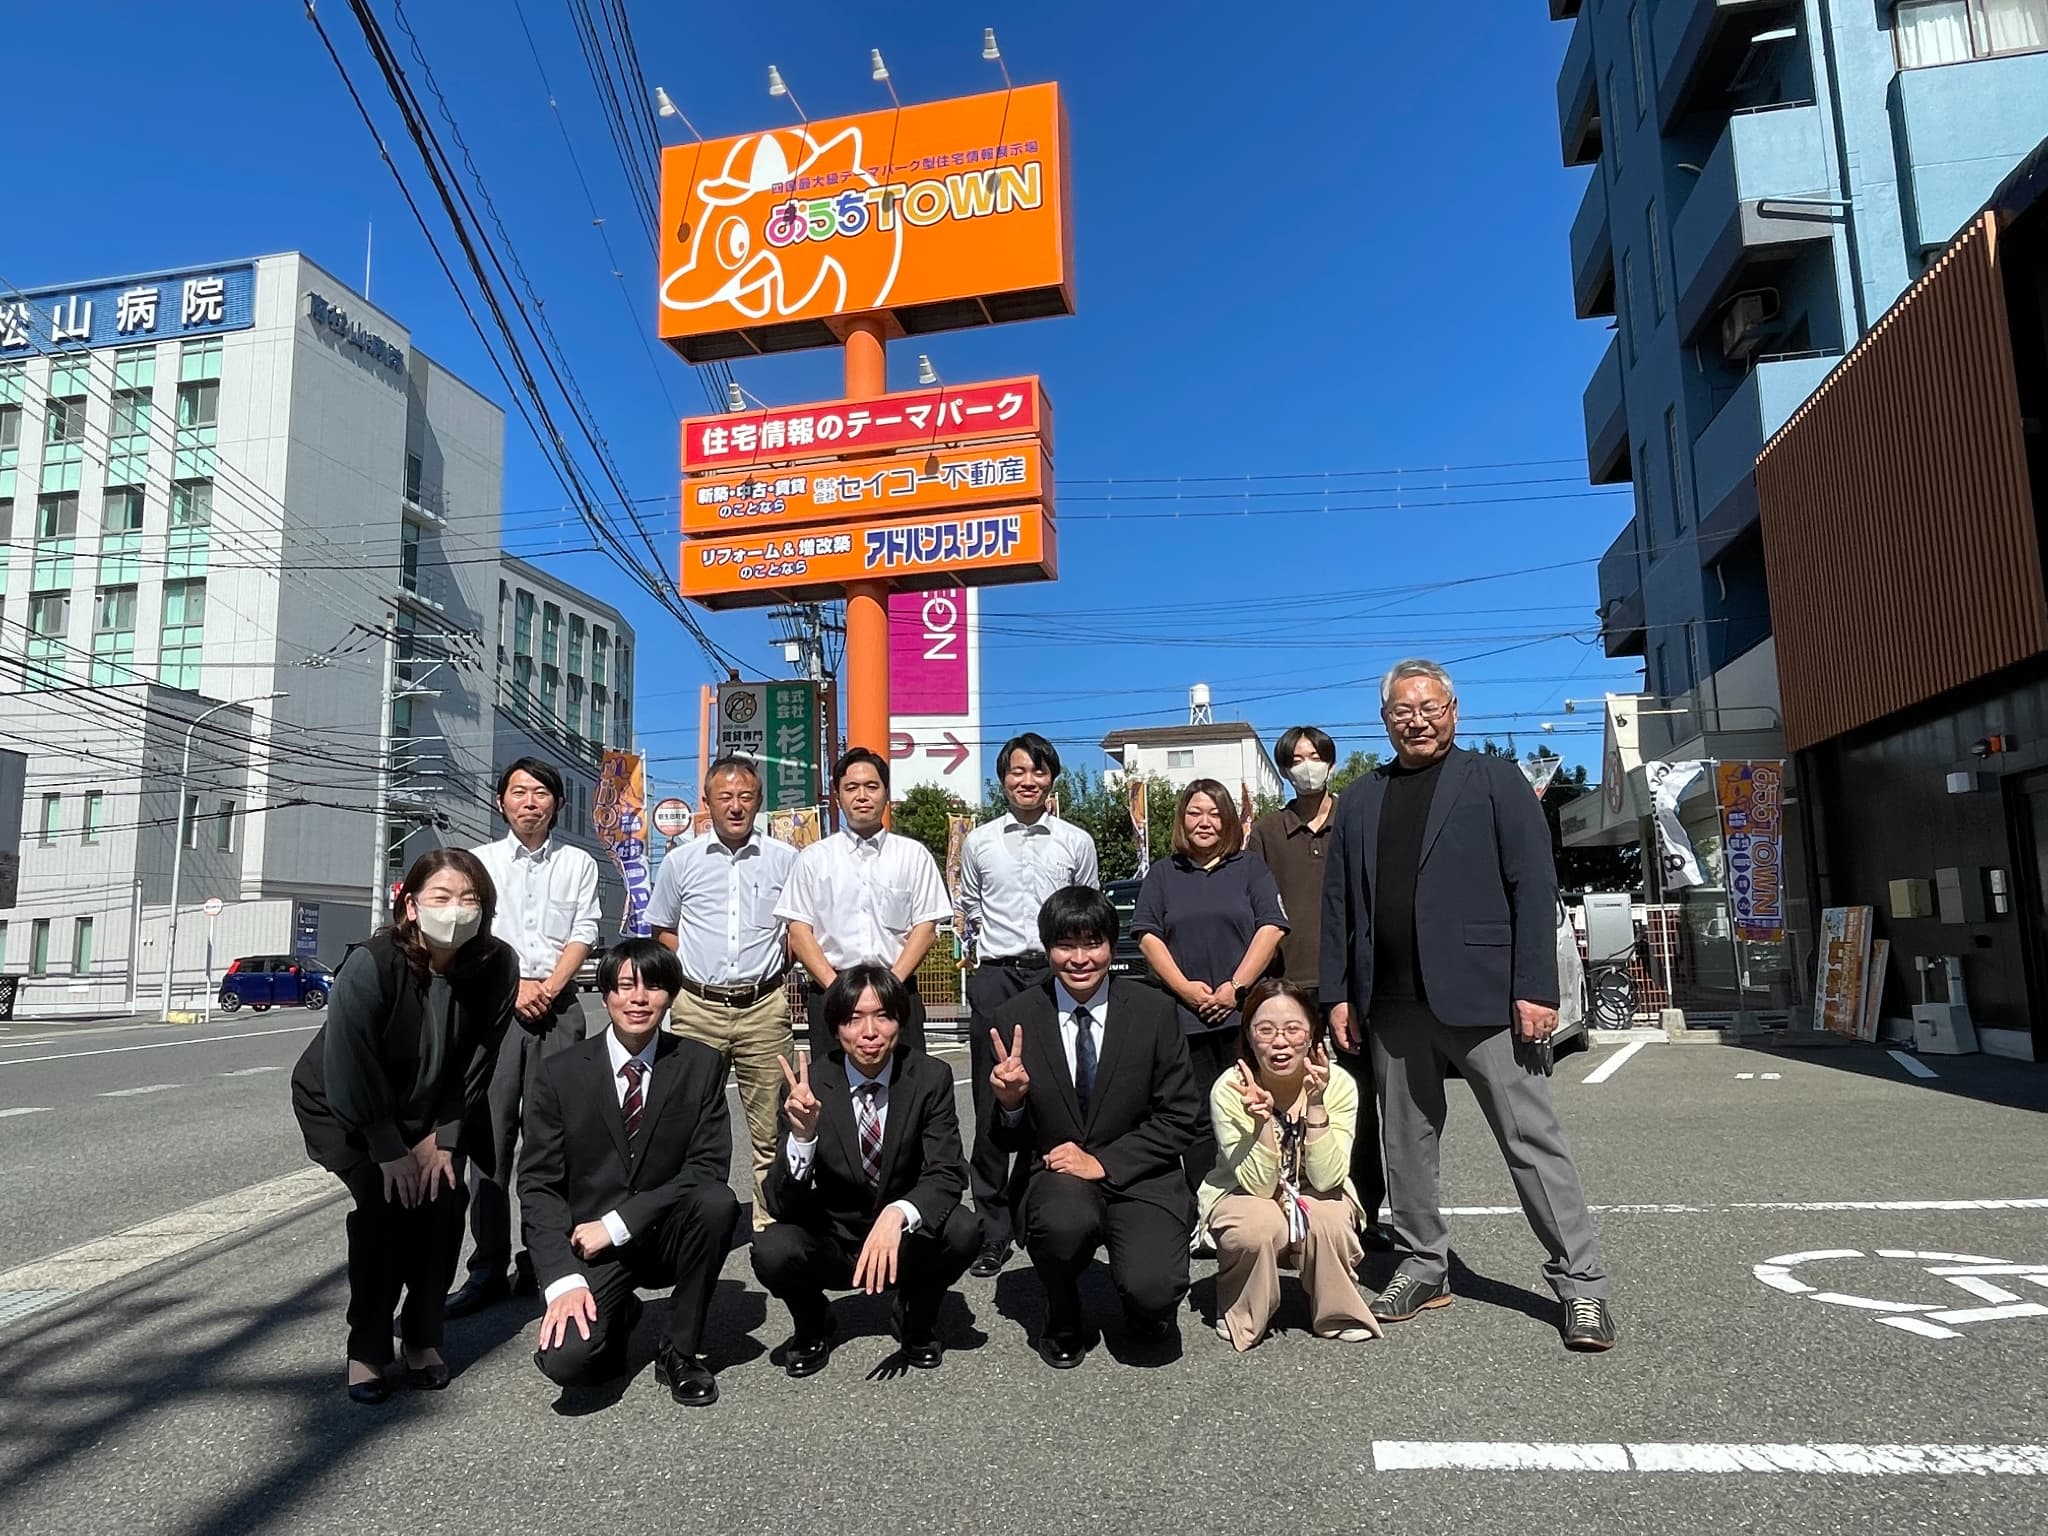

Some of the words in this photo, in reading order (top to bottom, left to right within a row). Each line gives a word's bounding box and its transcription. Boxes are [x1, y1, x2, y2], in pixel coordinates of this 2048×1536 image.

[702, 392, 1024, 456] 住宅情報のテーマパーク
[697, 478, 806, 504] 新築・中古・賃貸
[837, 456, 1026, 501] セイコー不動産
[719, 500, 785, 518] のことなら
[740, 561, 807, 579] のことなら
